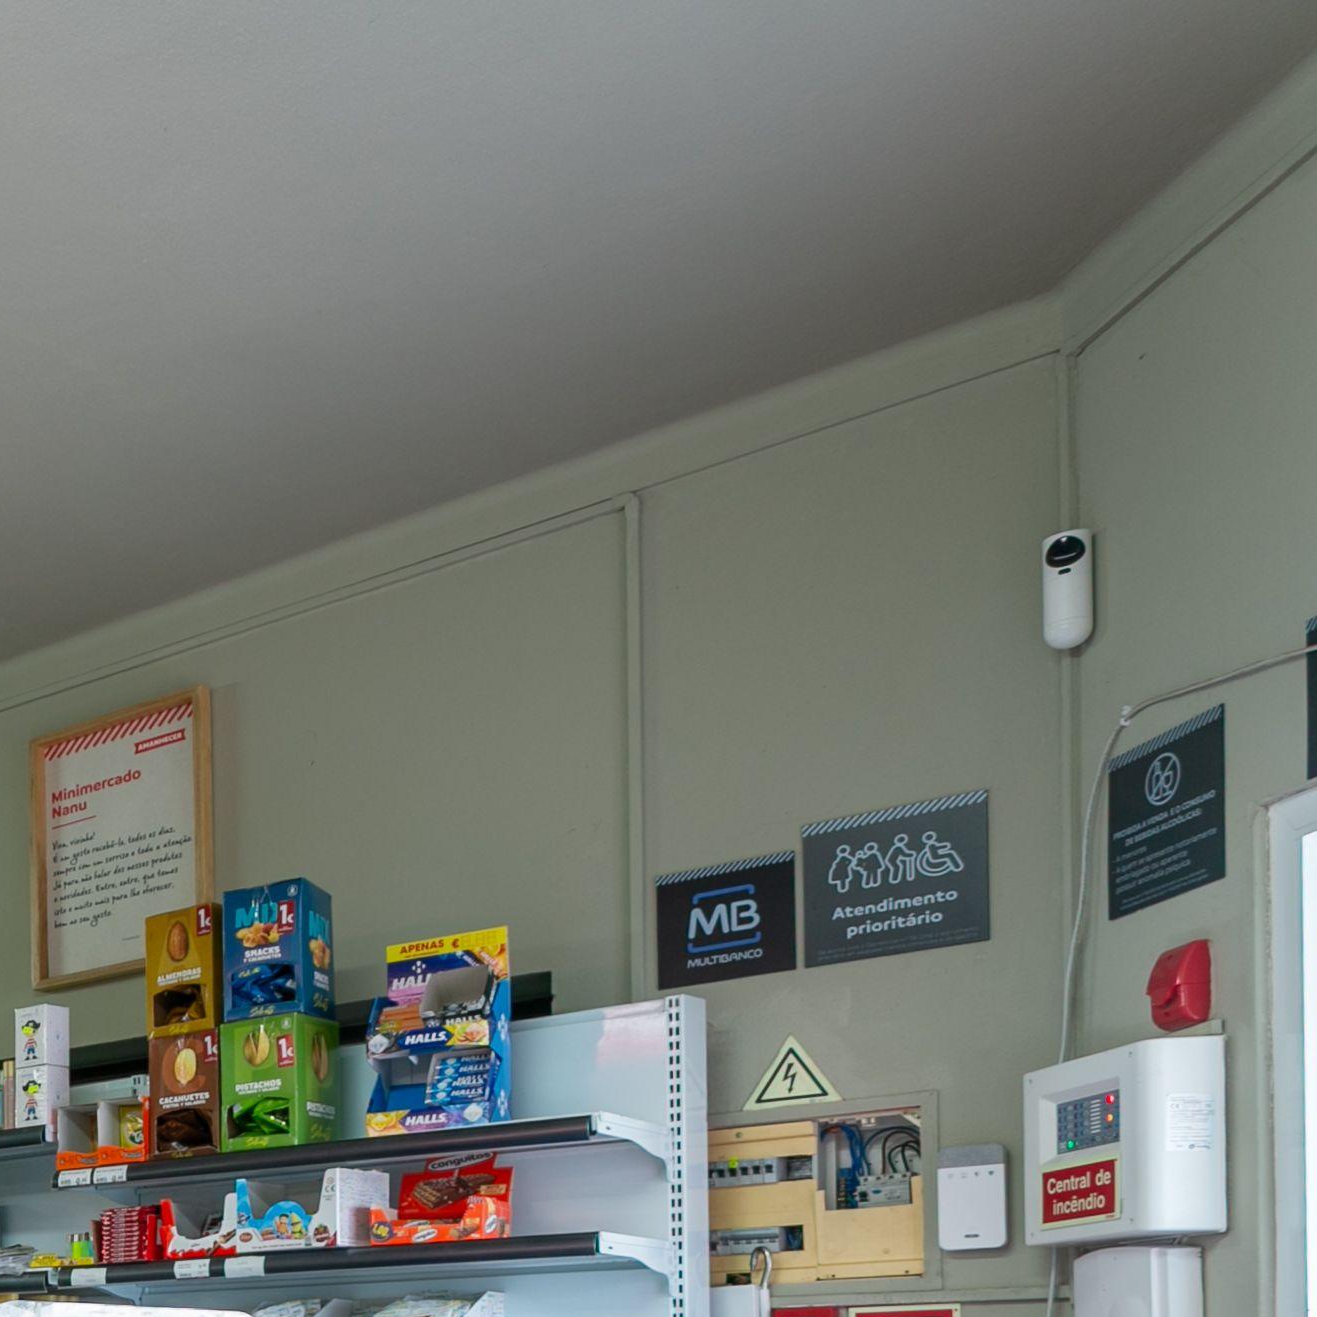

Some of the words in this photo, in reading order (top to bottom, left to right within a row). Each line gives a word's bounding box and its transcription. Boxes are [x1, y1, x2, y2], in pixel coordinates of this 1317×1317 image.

[51, 769, 141, 804] Minimercado
[52, 801, 87, 819] Nanu
[832, 888, 958, 920] Atendimento
[687, 899, 760, 939] MB
[846, 910, 943, 939] prioritário
[244, 946, 280, 958] SNACKS
[400, 939, 444, 955] APENAS
[687, 948, 763, 968] MULTIBANCO
[446, 1014, 482, 1026] HALLS
[405, 1031, 447, 1045] HALLS
[235, 1078, 282, 1092] PISTACHOS
[159, 1092, 210, 1104] CACAHUETES
[405, 1113, 447, 1127] HALLS
[430, 1152, 492, 1170] conguitos
[1047, 1172, 1091, 1195] Central
[1095, 1169, 1111, 1185] de
[1053, 1193, 1105, 1215] incêndio
